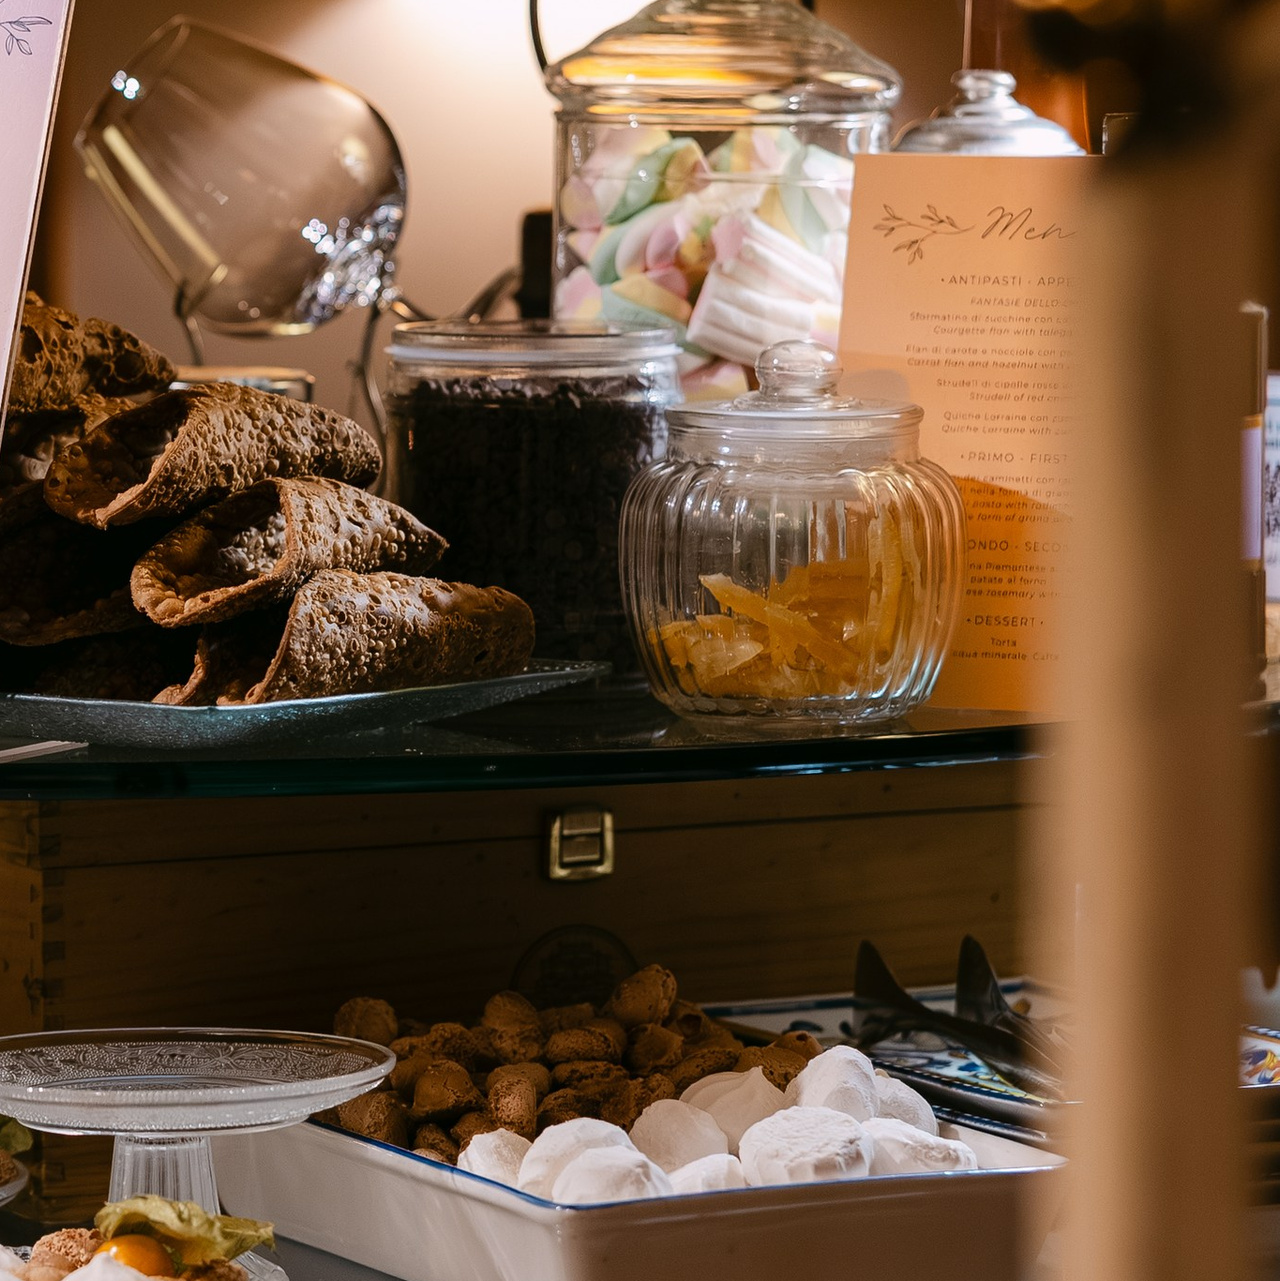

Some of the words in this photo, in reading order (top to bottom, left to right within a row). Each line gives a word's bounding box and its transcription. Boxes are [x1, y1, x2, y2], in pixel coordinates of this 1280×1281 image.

[982, 206, 1077, 240] Men
[948, 275, 1021, 286] ANTIPASTI
[970, 298, 1020, 307] FANTASIE
[1025, 299, 1058, 308] DELLO
[968, 452, 1014, 462] PRIMO
[974, 615, 1035, 626] DESSERT
